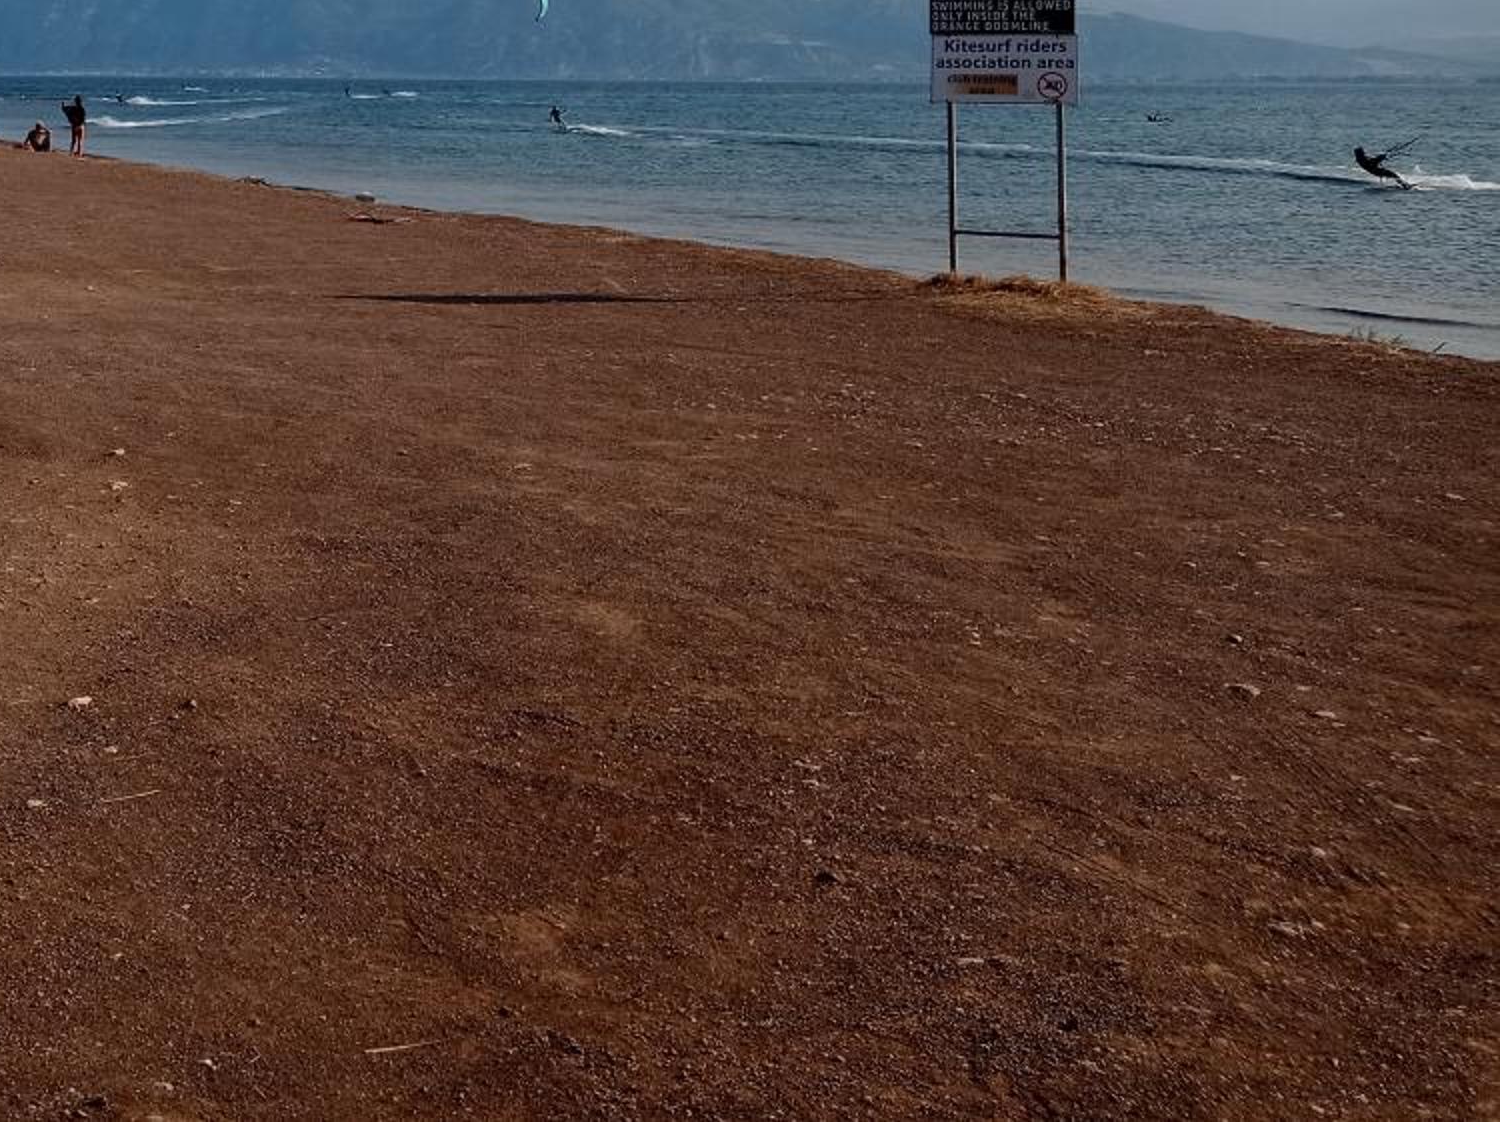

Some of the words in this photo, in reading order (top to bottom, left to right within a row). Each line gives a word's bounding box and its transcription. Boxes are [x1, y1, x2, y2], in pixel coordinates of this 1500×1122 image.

[1013, 0, 1071, 11] ALLOWED
[932, 11, 963, 21] ONLY
[967, 11, 1009, 21] INSIDE
[1012, 11, 1036, 21] THE
[945, 38, 1012, 53] Kitesurf
[1017, 38, 1067, 53] riders
[936, 55, 1031, 69] association
[1037, 59, 1075, 69] area
